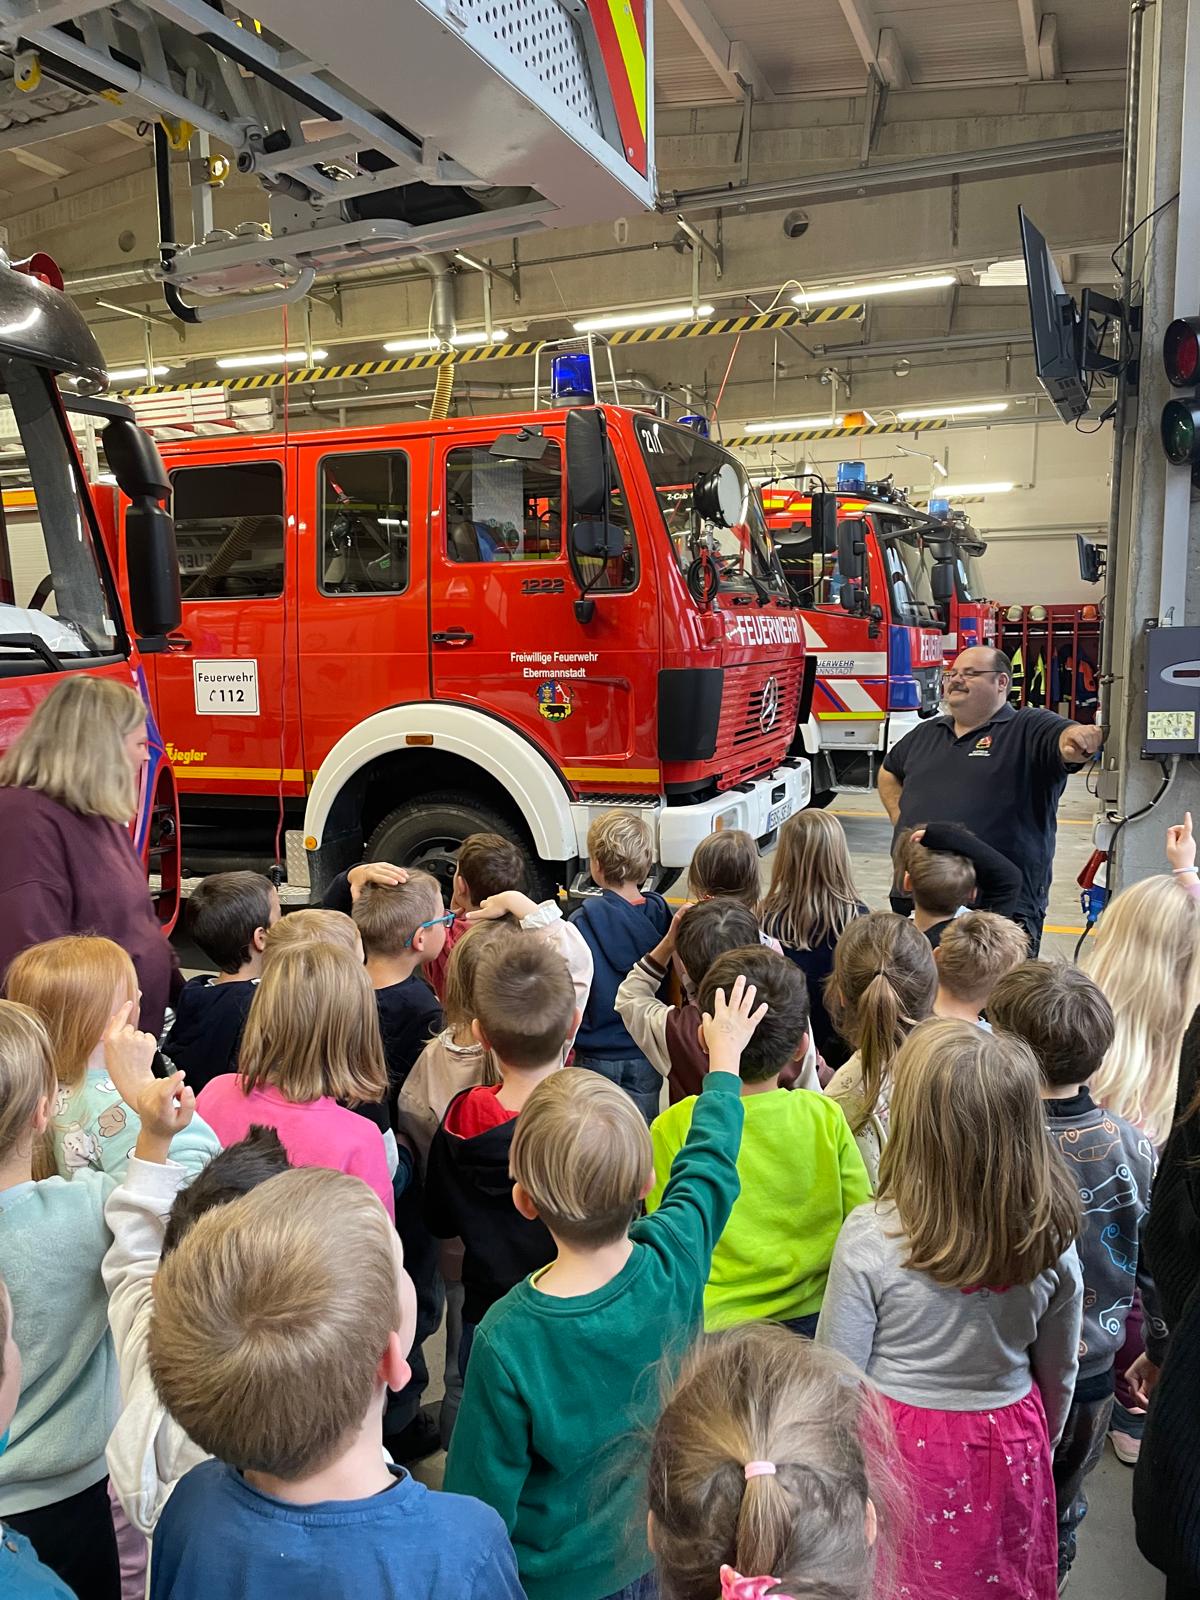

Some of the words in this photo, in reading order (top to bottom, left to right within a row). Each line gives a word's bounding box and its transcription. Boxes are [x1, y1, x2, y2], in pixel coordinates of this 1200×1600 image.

[520, 578, 566, 591] 1222
[736, 615, 800, 647] FEUERWEHR
[510, 652, 552, 664] Freiwillige
[553, 651, 599, 662] Feuerwehr
[198, 672, 254, 683] Feuerwehr
[523, 667, 586, 678] Ebermannstadt
[219, 689, 245, 702] 112
